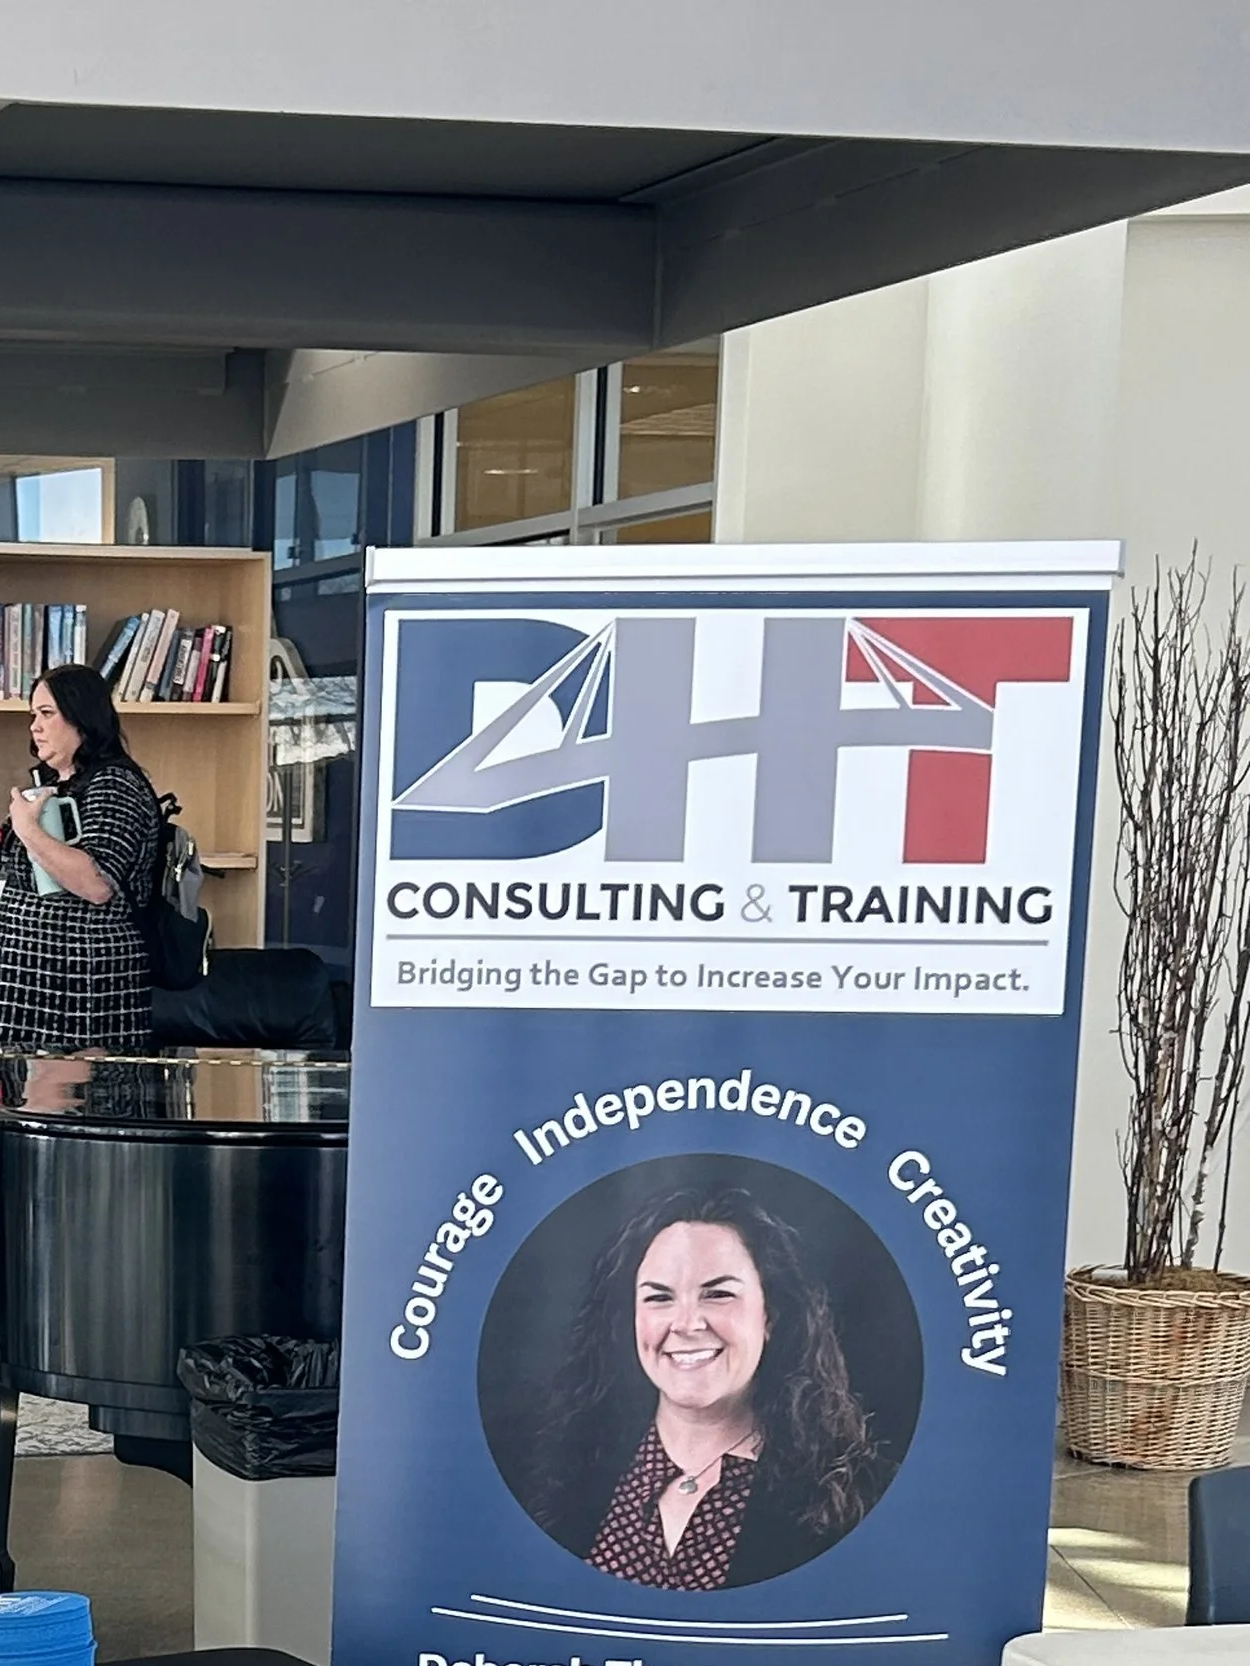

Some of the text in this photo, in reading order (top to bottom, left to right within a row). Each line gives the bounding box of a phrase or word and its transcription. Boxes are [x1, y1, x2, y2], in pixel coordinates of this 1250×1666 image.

[390, 617, 1074, 863] DHT
[386, 881, 1053, 925] CONSULTING & TRAINING
[396, 960, 1031, 996] Bridging the Gap to Increase Your Impact.
[389, 1069, 1015, 1377] Courage Independence Creativity
